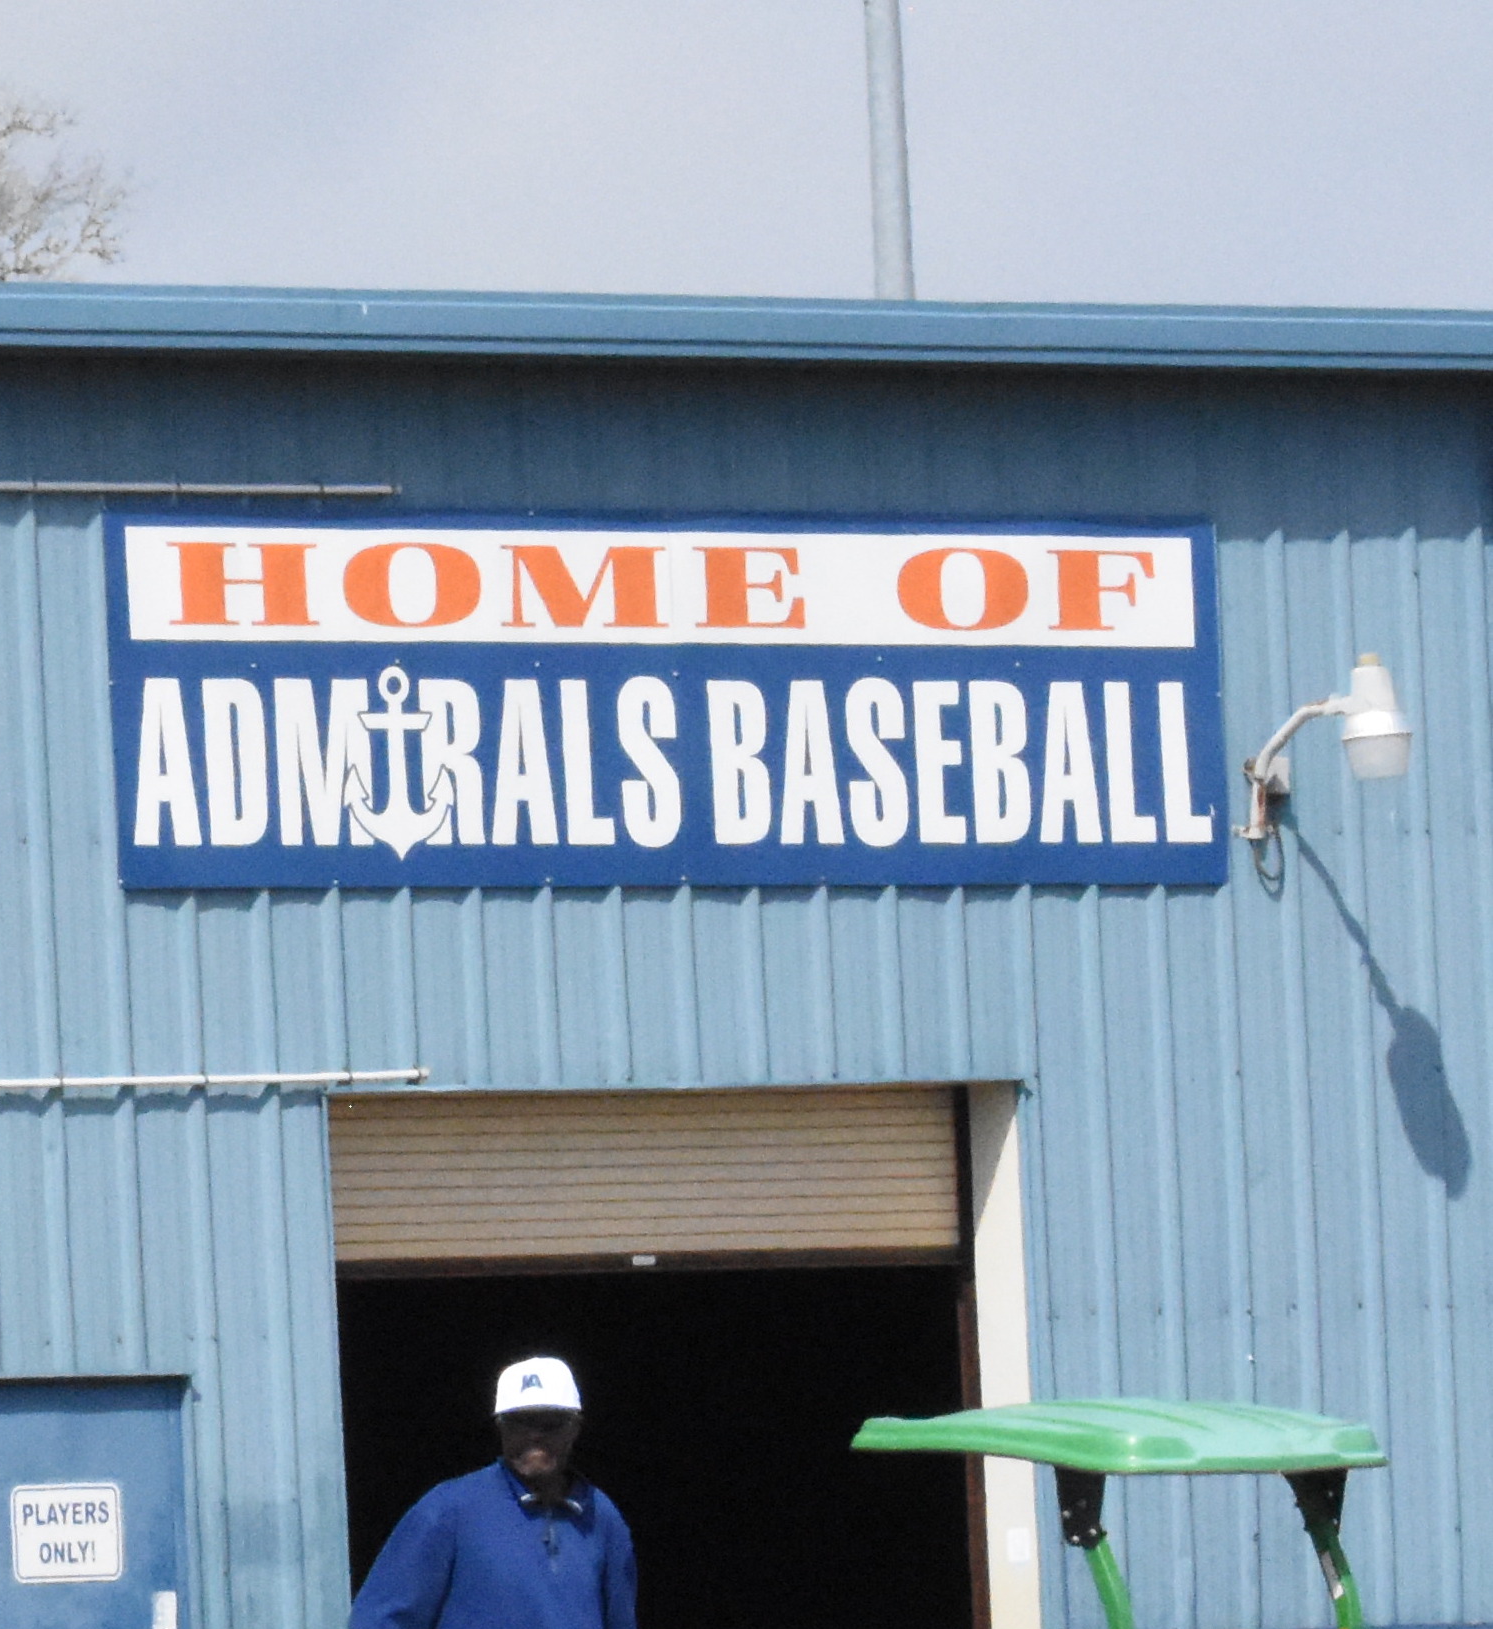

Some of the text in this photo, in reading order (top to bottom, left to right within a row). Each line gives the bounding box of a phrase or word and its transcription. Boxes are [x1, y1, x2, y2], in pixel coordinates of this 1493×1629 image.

[165, 540, 1156, 632] HOME OF
[706, 676, 1214, 846] BASEBALL
[22, 1500, 110, 1526] PLAYERS
[38, 1540, 96, 1566] ONLY!
